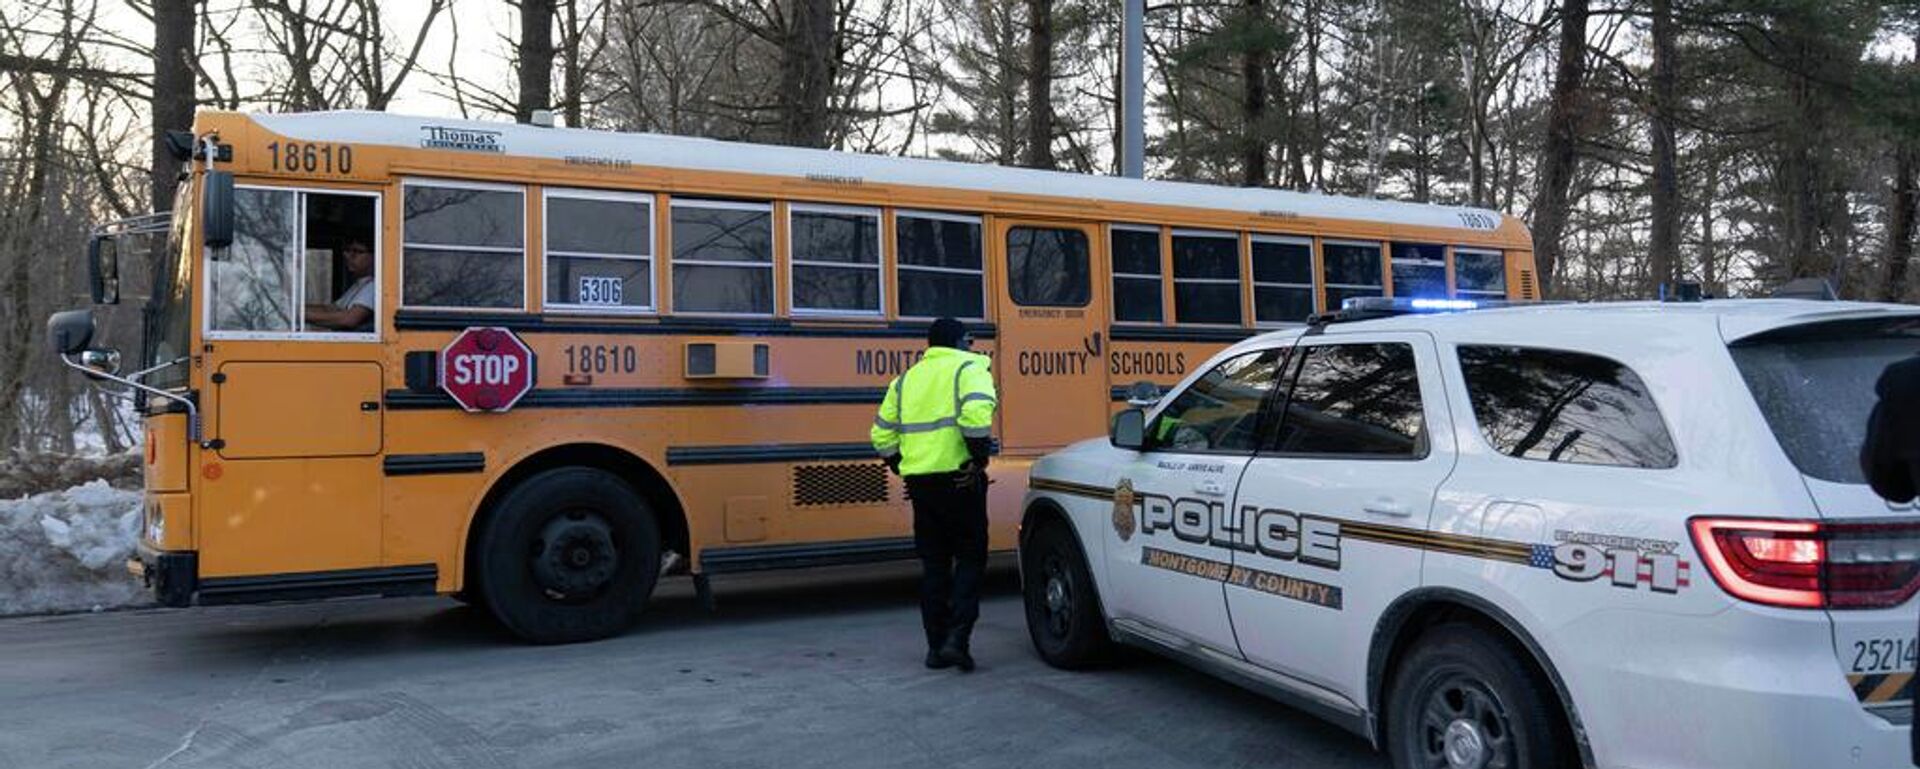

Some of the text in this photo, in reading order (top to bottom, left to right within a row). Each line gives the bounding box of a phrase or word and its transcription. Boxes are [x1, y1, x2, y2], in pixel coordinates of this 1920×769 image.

[421, 126, 502, 144] Thomas
[267, 142, 352, 174] 18610
[581, 279, 621, 302] 5306
[454, 354, 519, 385] STOP
[564, 345, 636, 373] 18610
[1019, 351, 1087, 375] COUNTY
[1111, 351, 1185, 375] SCHOOLS
[1141, 493, 1341, 570] POLICE
[1554, 530, 1679, 554] EMERGENCY
[1149, 551, 1330, 604] MONTGOMERY COUNTY
[1552, 541, 1679, 594] 911
[1852, 638, 1917, 672] 25214
